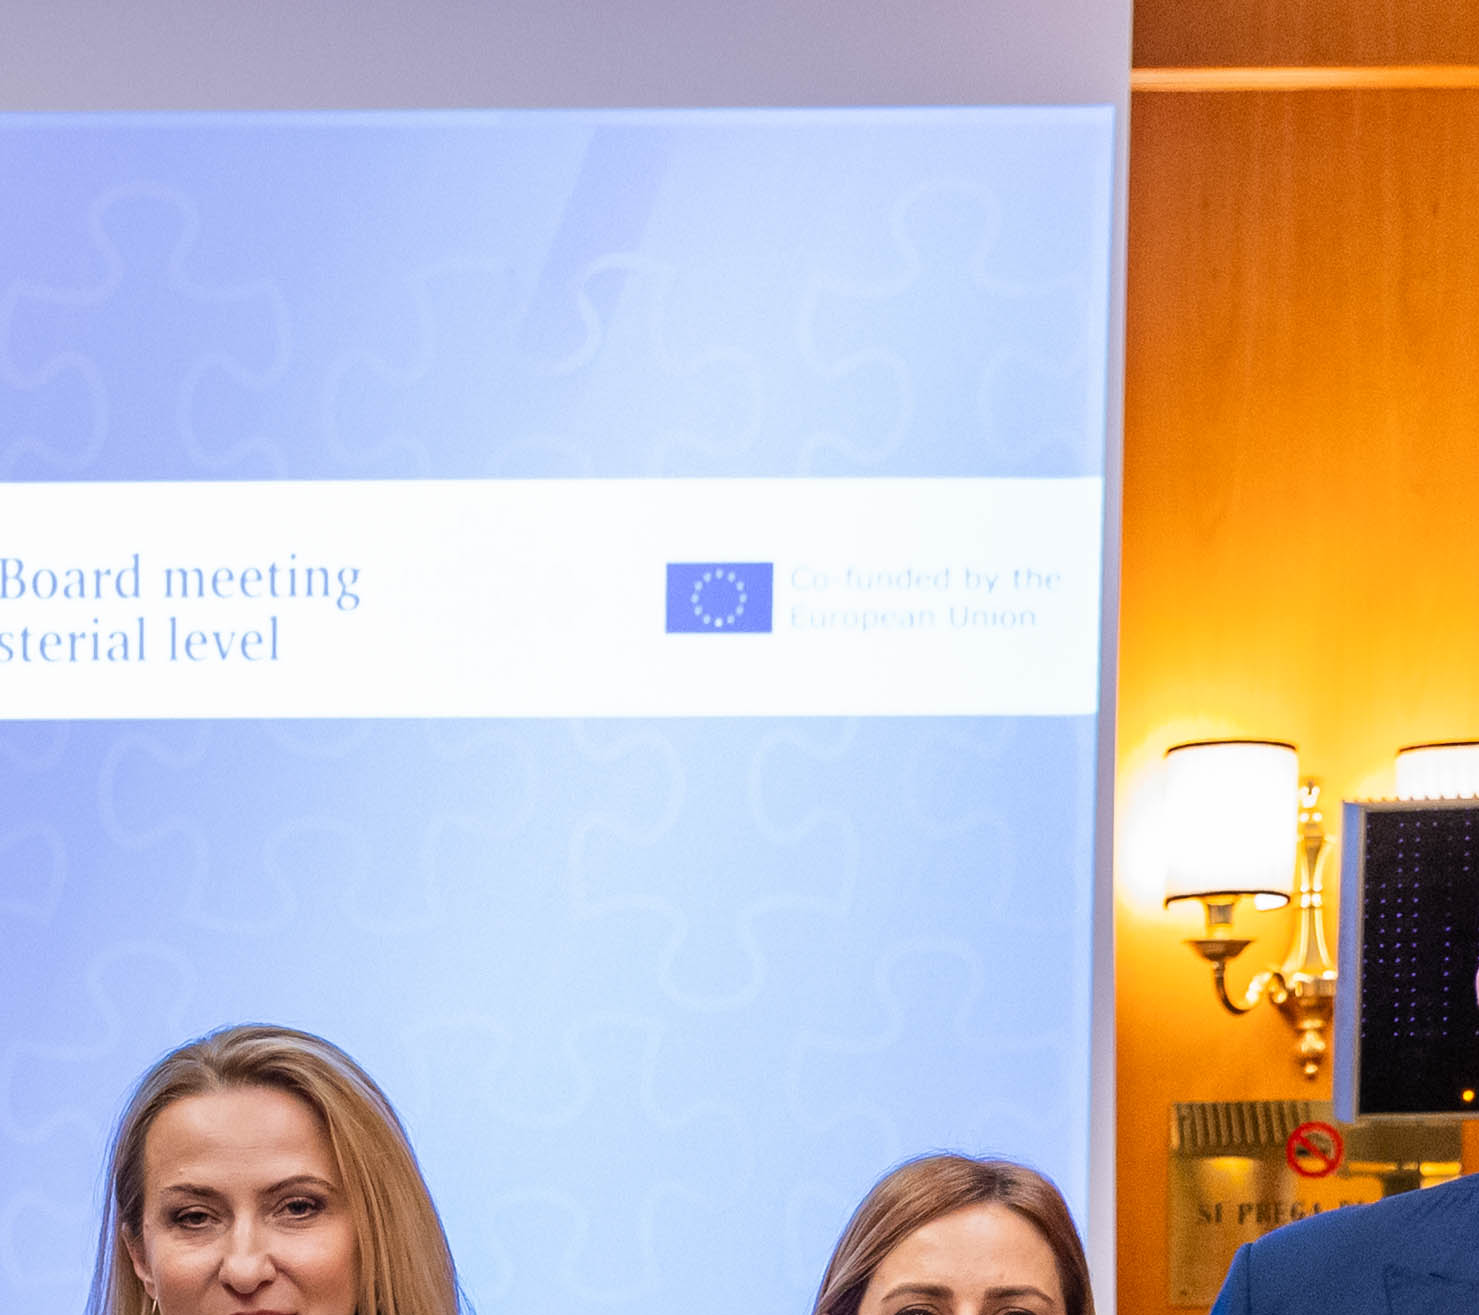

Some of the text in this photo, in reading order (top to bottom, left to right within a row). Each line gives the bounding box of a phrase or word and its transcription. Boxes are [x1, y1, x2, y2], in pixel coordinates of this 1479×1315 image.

[0, 553, 141, 601] Board
[164, 553, 361, 612] meeting
[790, 567, 1062, 595] Co-funded by the
[790, 606, 1037, 630] European Union
[169, 616, 280, 663] level
